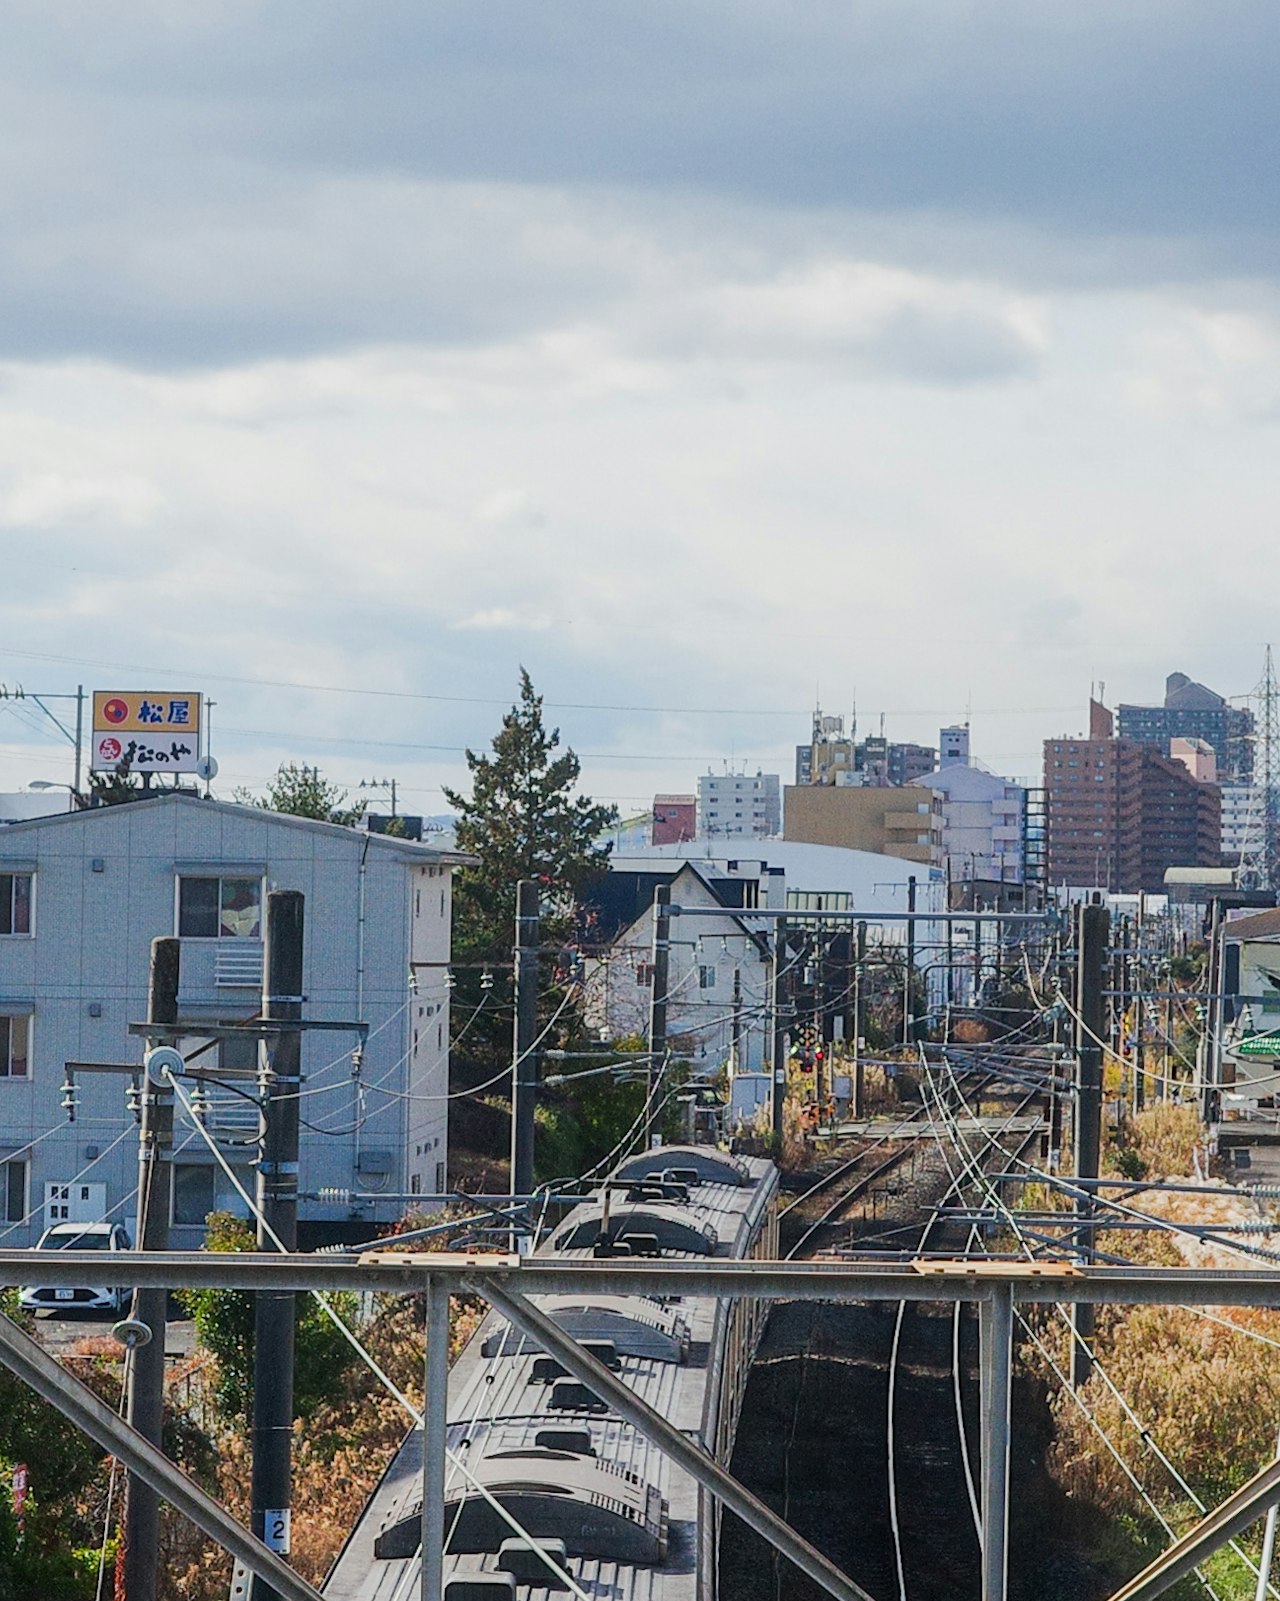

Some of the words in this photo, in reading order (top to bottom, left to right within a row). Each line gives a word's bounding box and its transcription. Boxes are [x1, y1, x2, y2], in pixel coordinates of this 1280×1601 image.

[138, 700, 189, 724] 松屋
[127, 740, 192, 763] 松のや
[272, 1520, 285, 1539] 2
